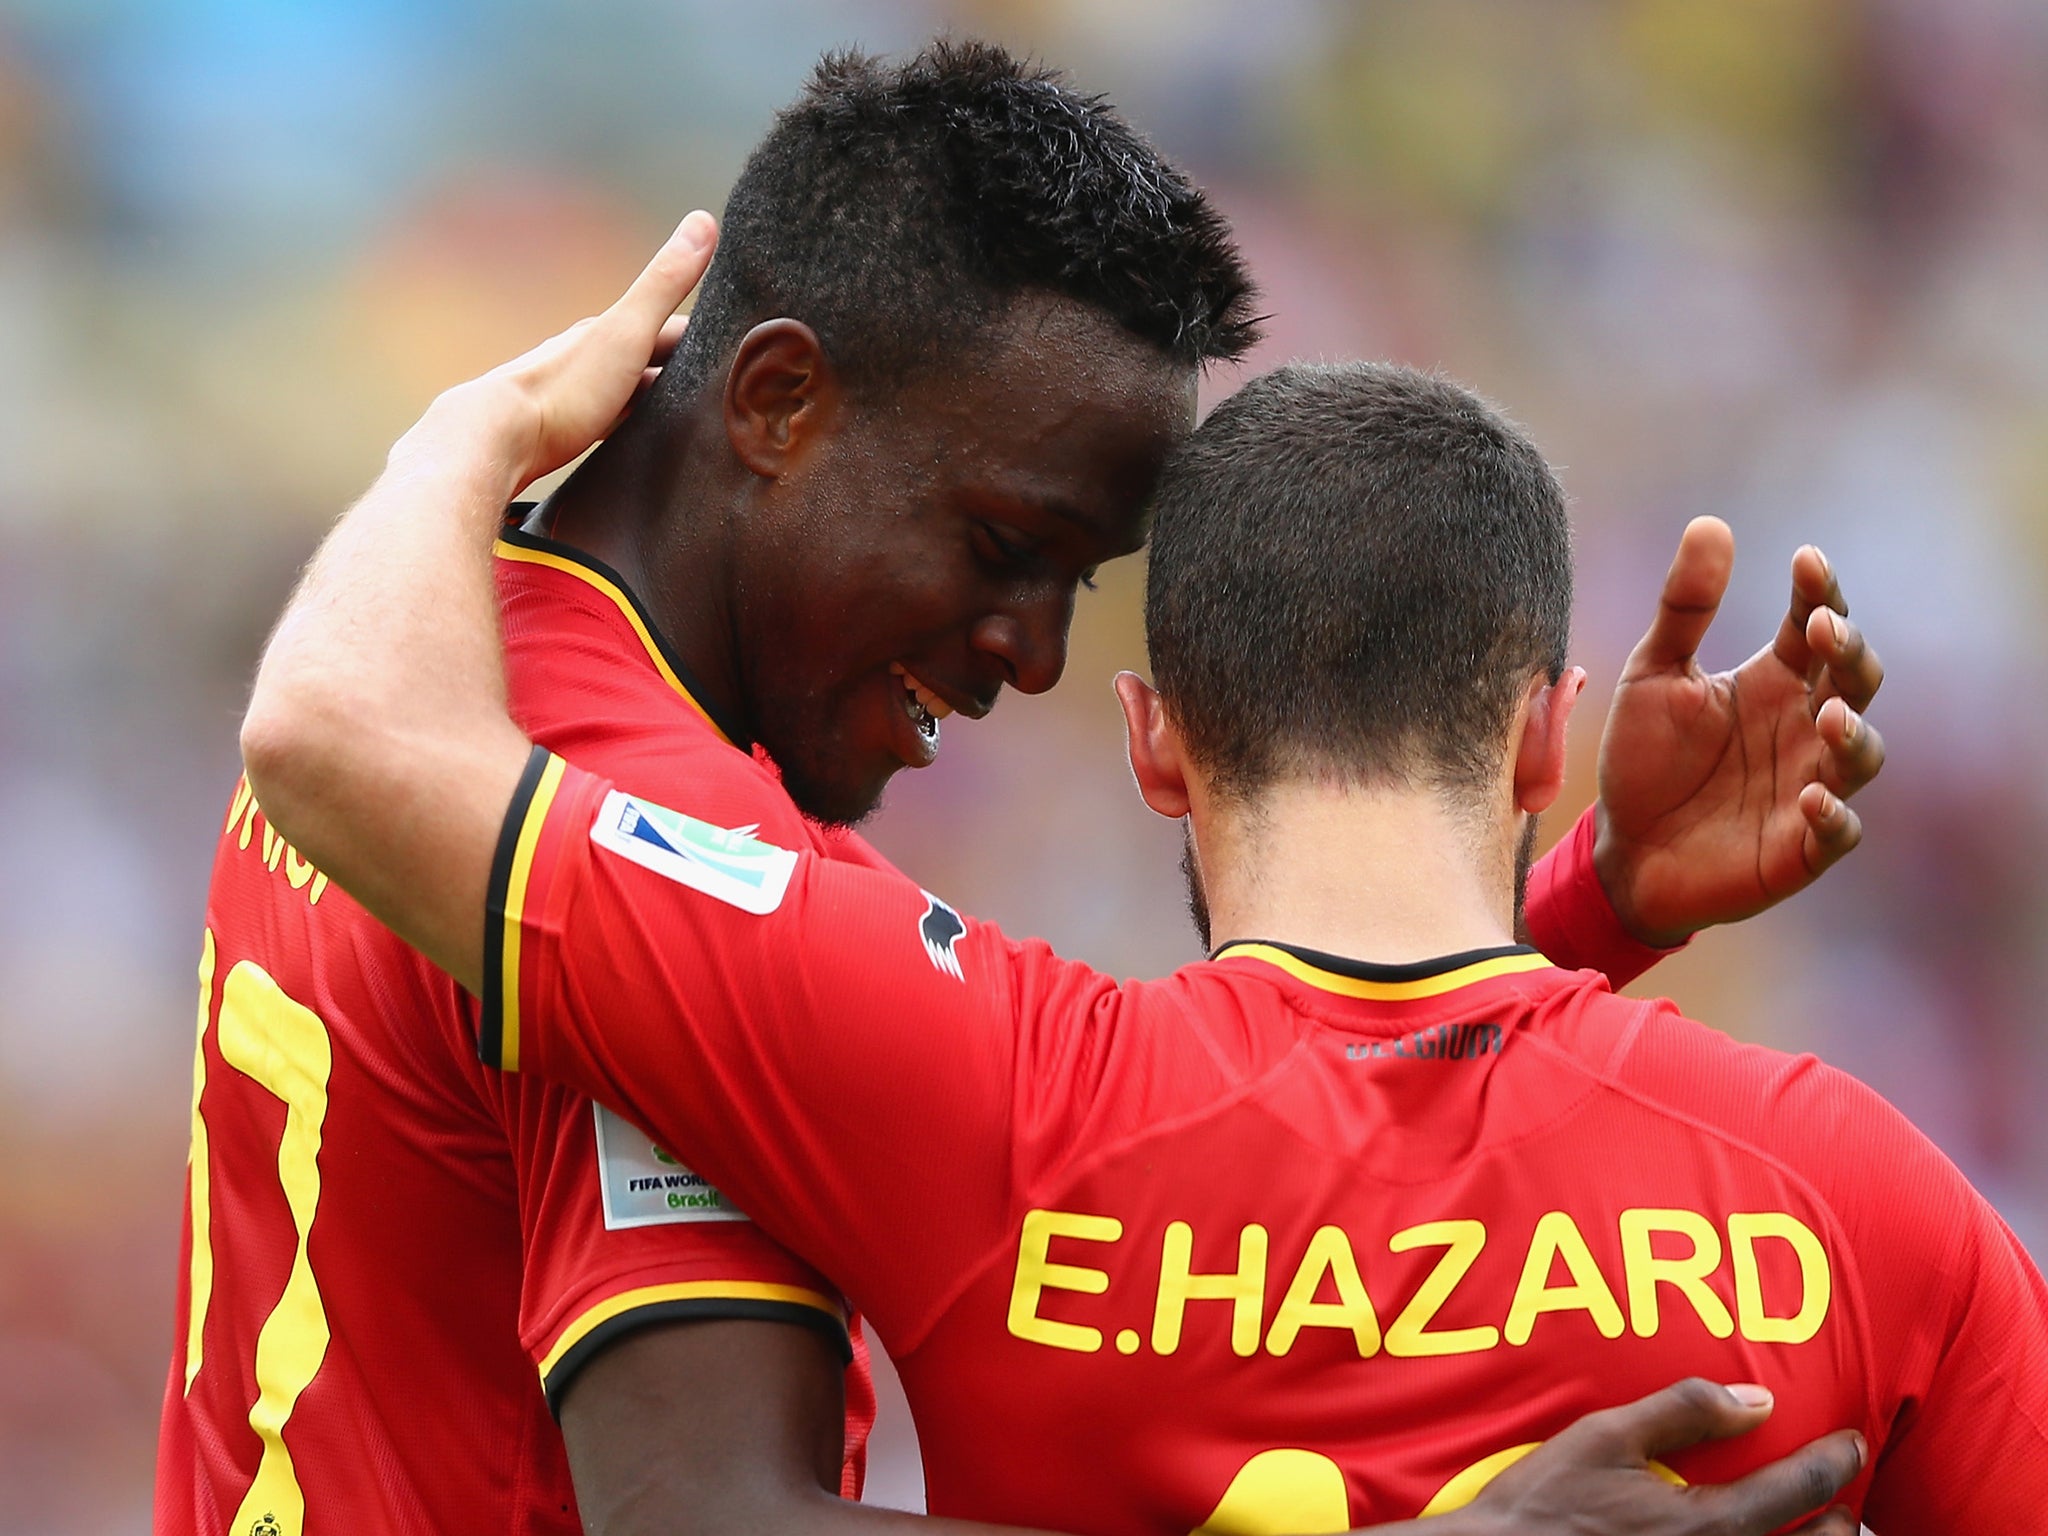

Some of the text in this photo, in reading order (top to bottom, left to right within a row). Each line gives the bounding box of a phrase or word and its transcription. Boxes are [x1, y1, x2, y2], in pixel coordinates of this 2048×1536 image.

[629, 1177, 662, 1192] FIFA
[667, 1190, 720, 1209] Brasil
[1007, 1208, 1831, 1358] E.HAZARD
